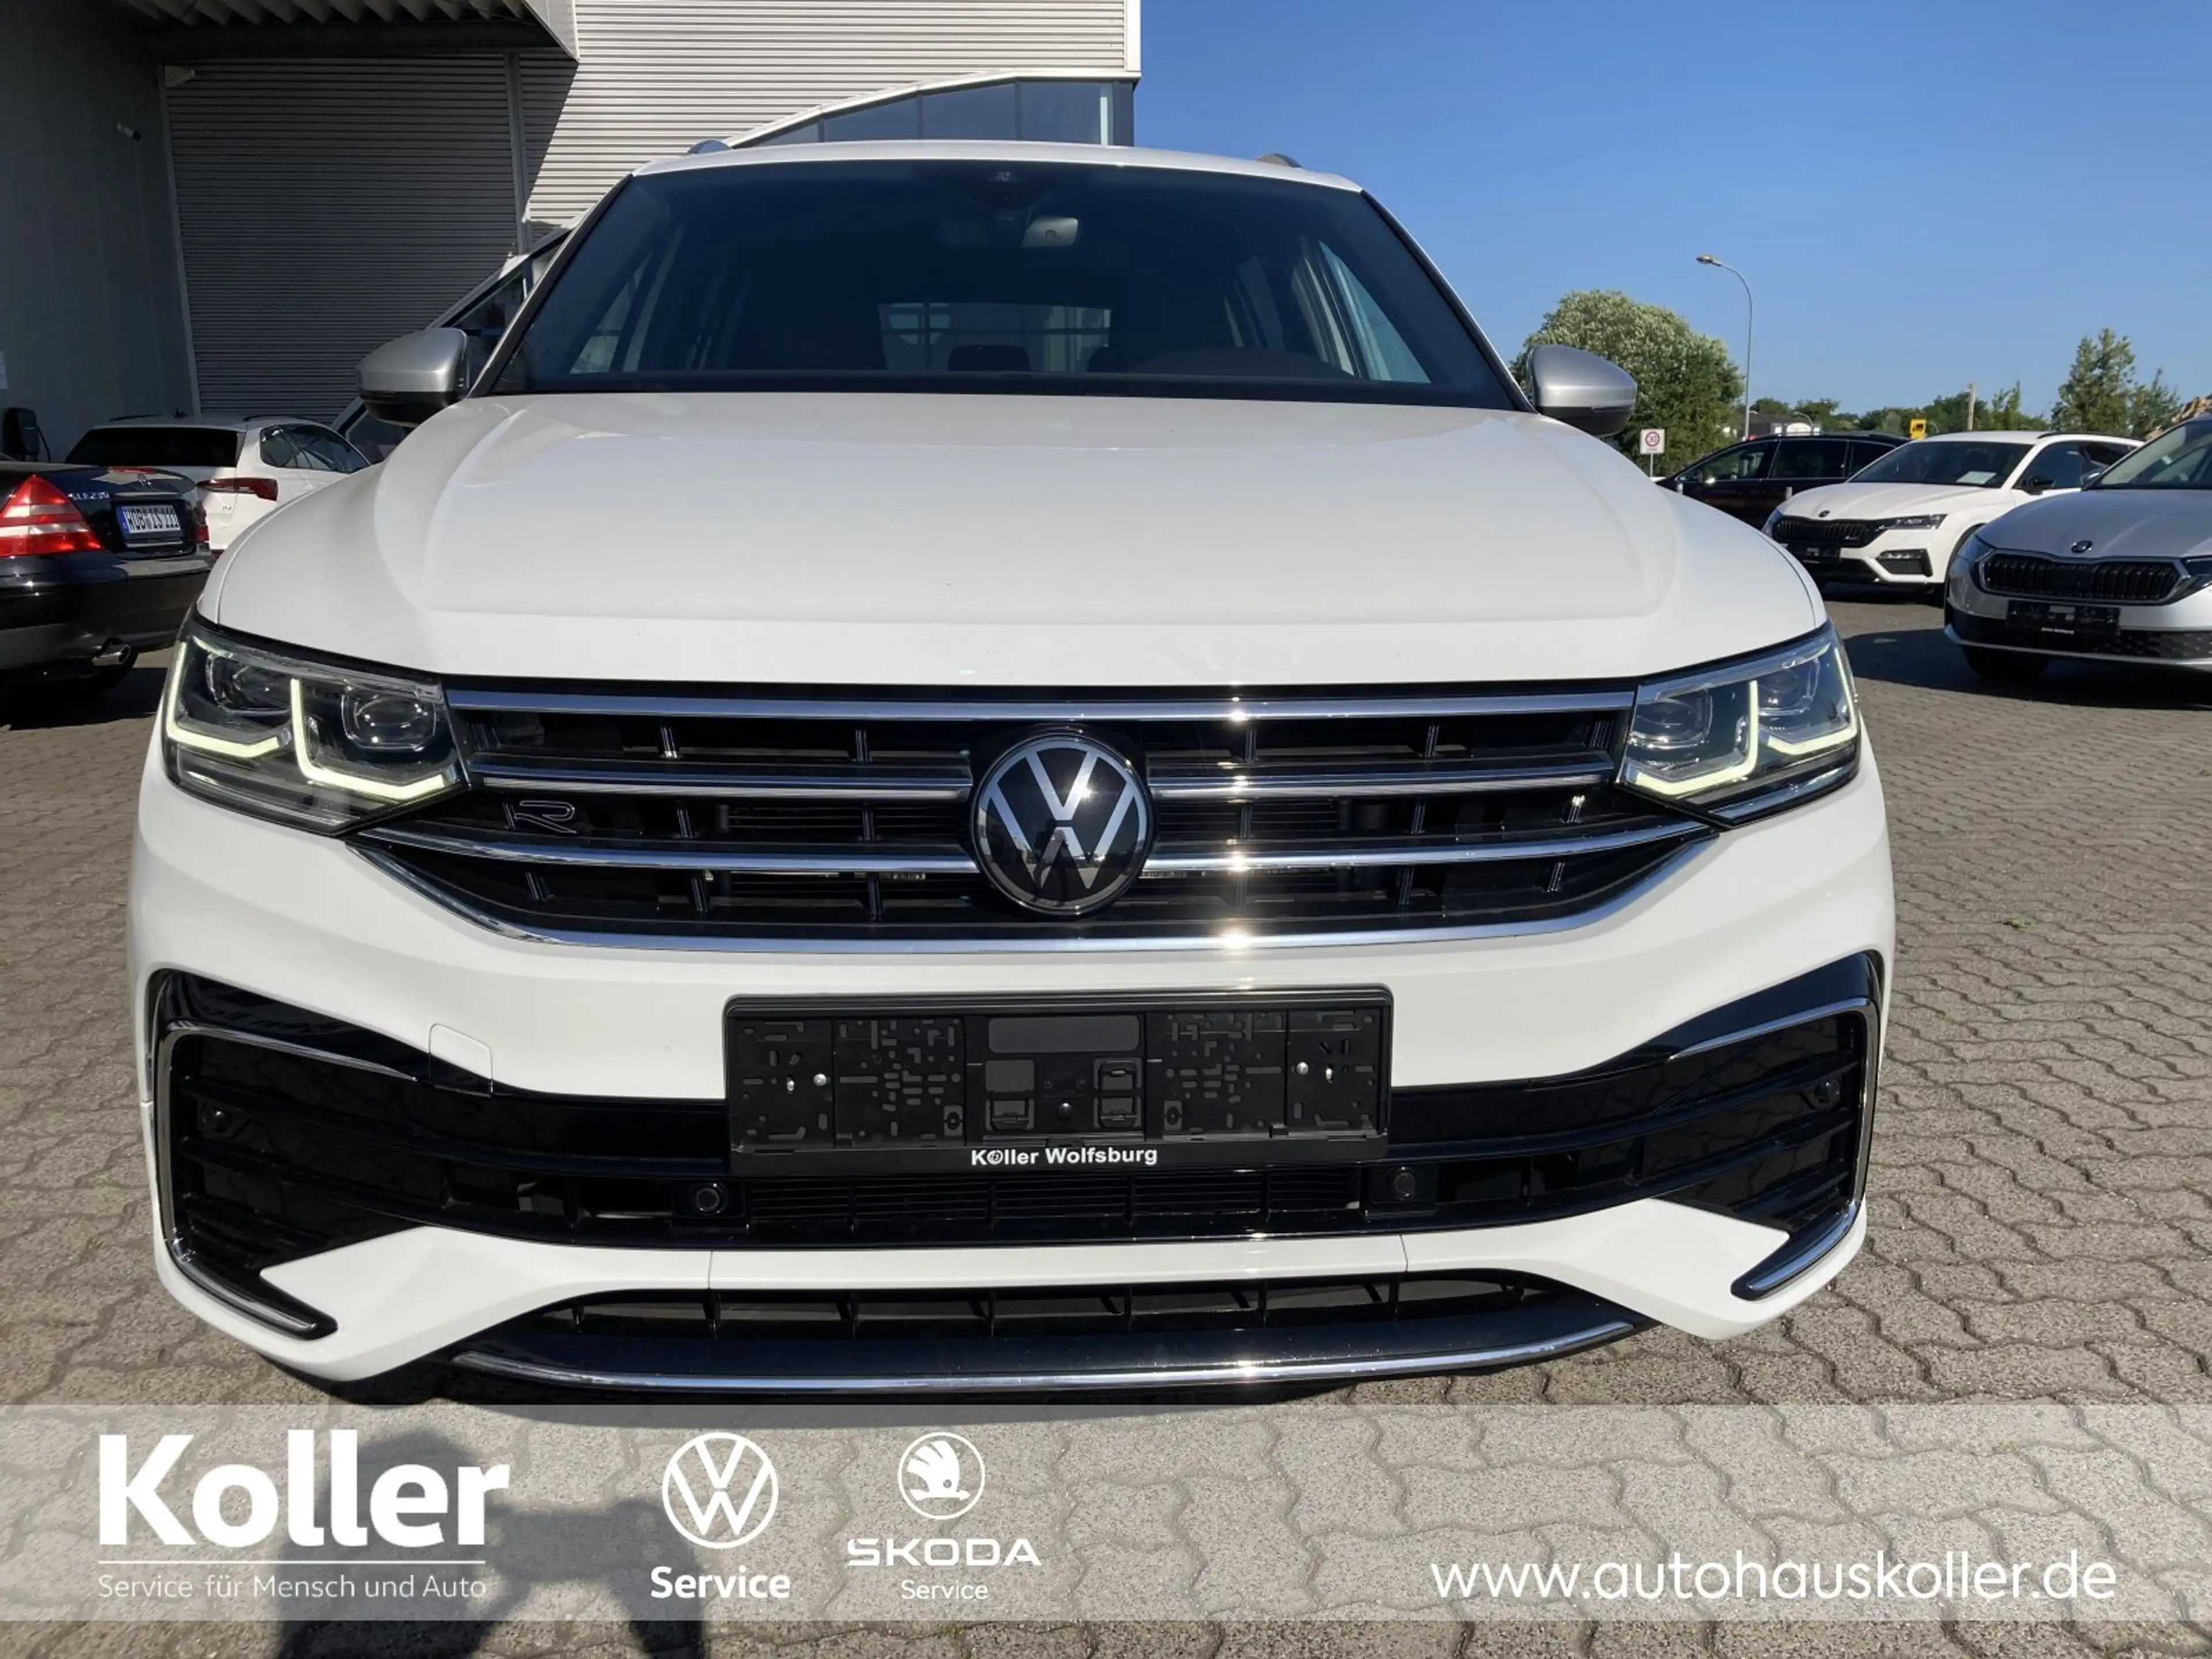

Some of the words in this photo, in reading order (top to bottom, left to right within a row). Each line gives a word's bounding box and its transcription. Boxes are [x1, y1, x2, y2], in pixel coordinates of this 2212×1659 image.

[123, 509, 146, 529] WOB
[502, 800, 577, 834] R
[1045, 1147, 1157, 1165] Wolfsburg
